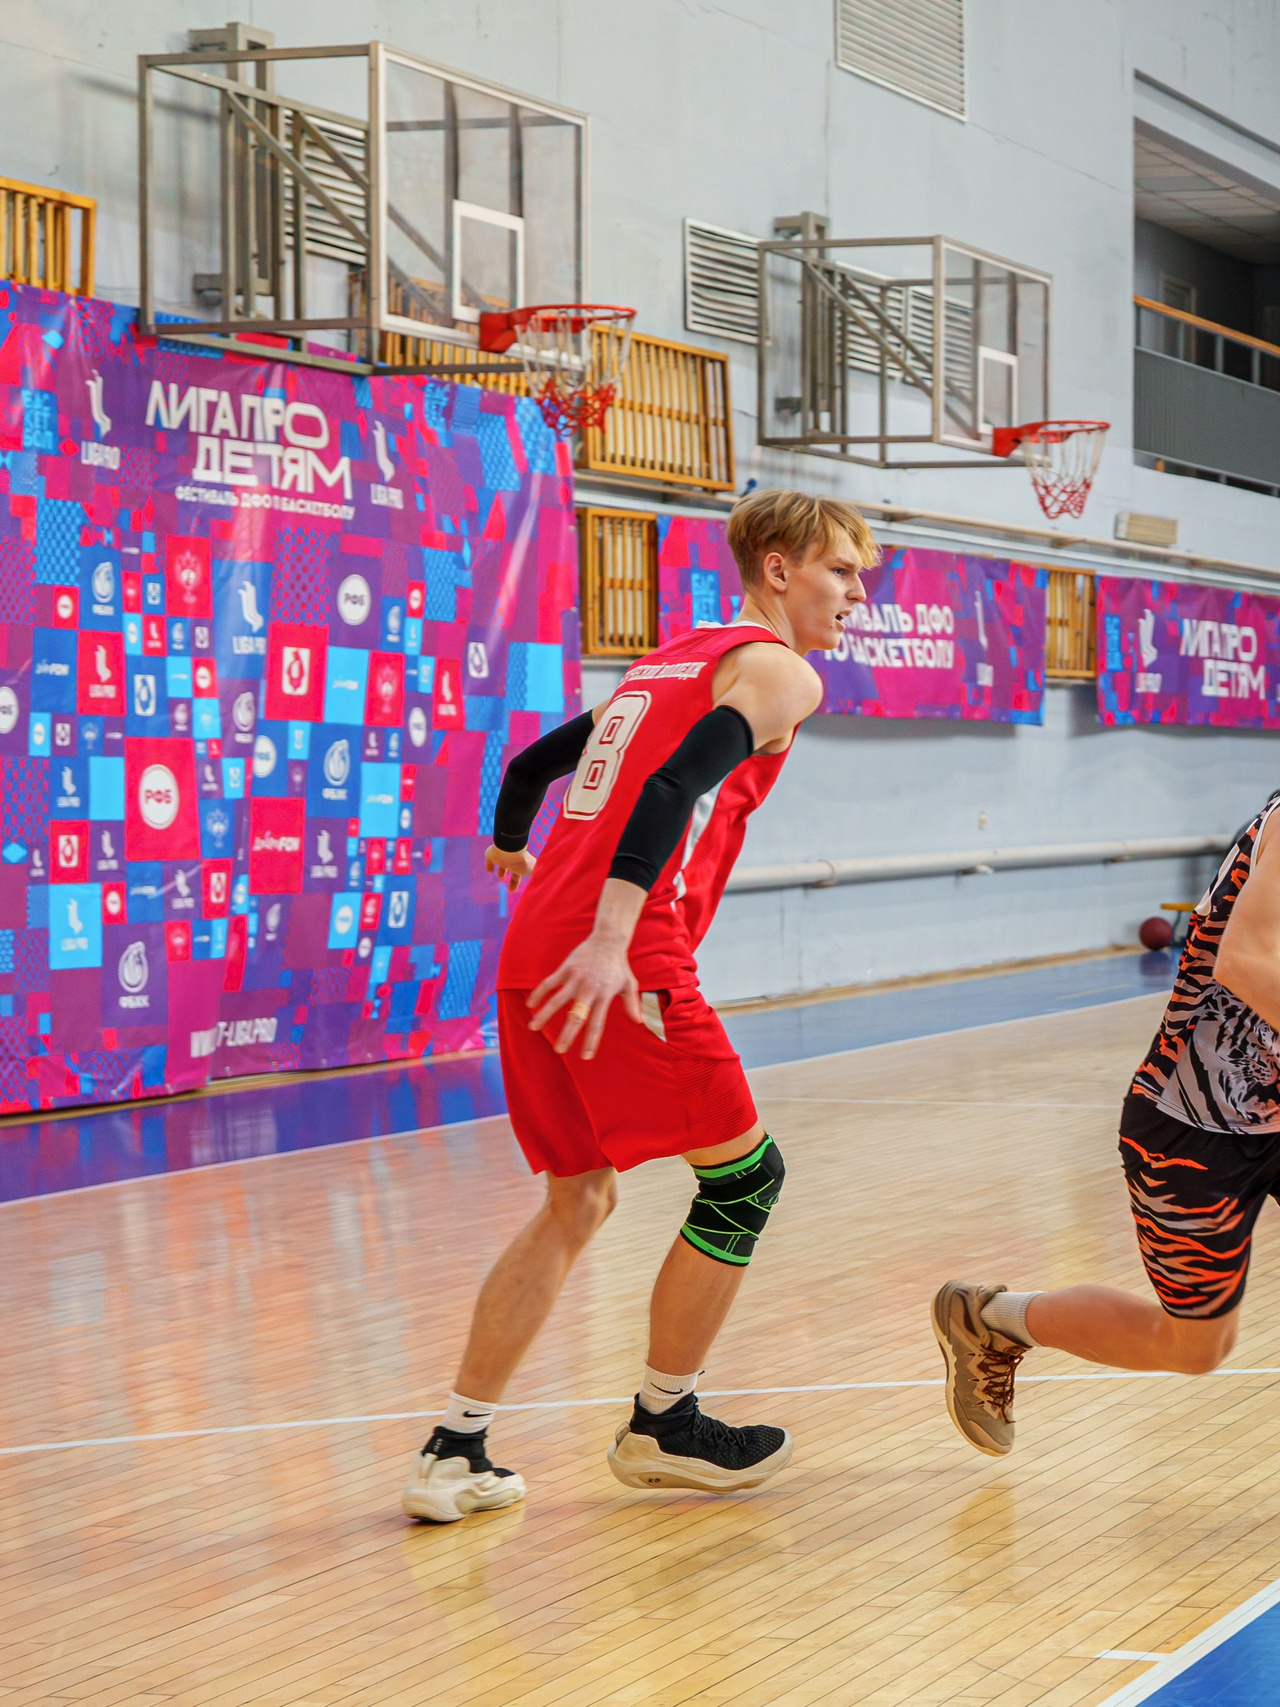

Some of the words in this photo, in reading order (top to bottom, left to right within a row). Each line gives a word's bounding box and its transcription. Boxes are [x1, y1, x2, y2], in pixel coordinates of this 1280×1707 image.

[192, 434, 353, 500] ДЕТЯМ
[915, 603, 955, 635] ДФО
[847, 632, 954, 669] БАСКЕТБОЛУ
[1201, 658, 1266, 700] ДЕТЯМ
[563, 690, 652, 821] 8
[144, 789, 172, 804] РФБ
